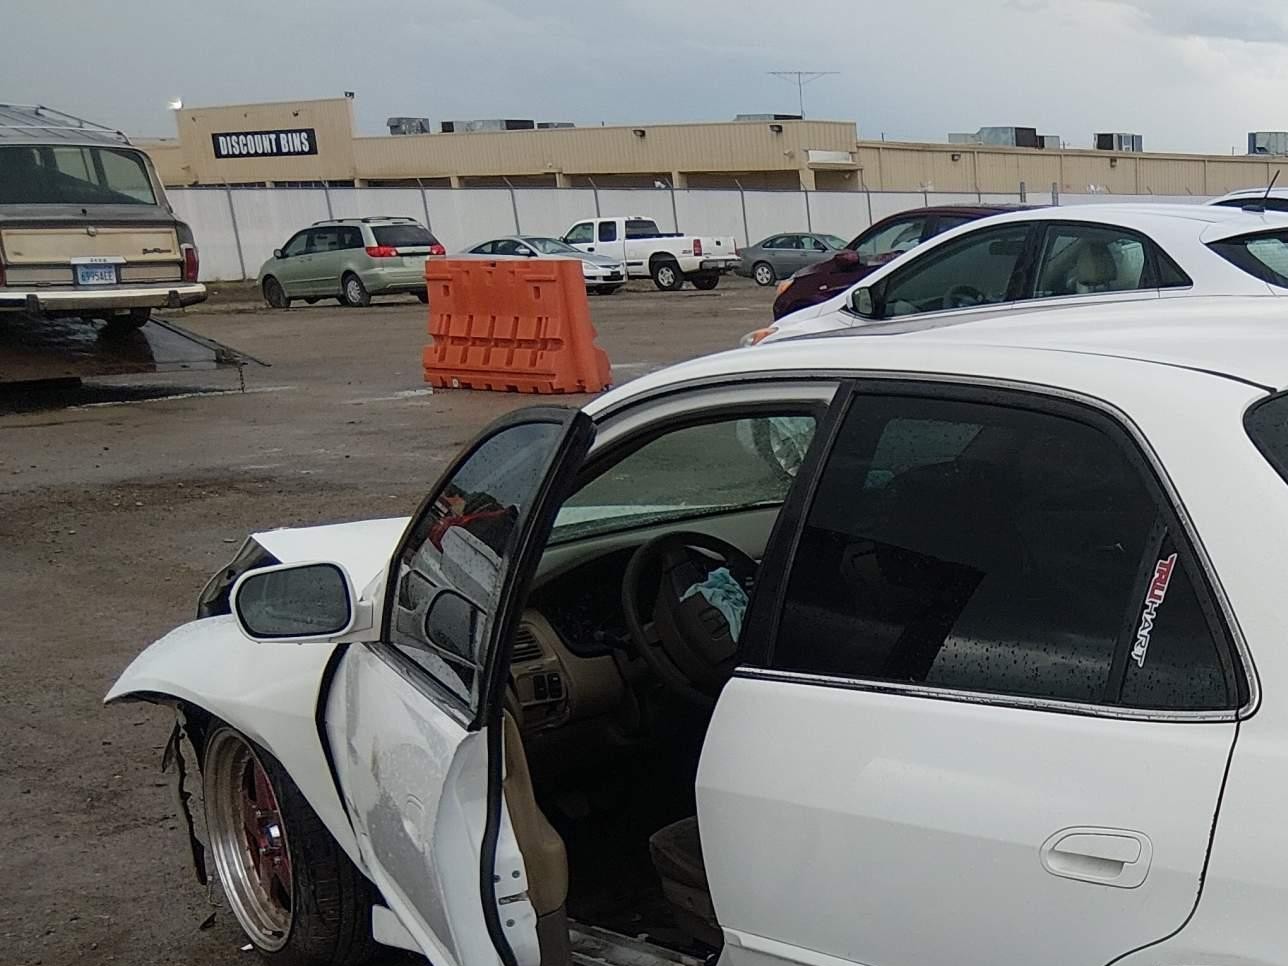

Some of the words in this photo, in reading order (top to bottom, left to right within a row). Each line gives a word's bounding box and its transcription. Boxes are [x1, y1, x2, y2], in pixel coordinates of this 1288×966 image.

[218, 134, 277, 155] DISCOUNT
[279, 132, 310, 153] BINS
[1131, 553, 1178, 668] TRUHART
